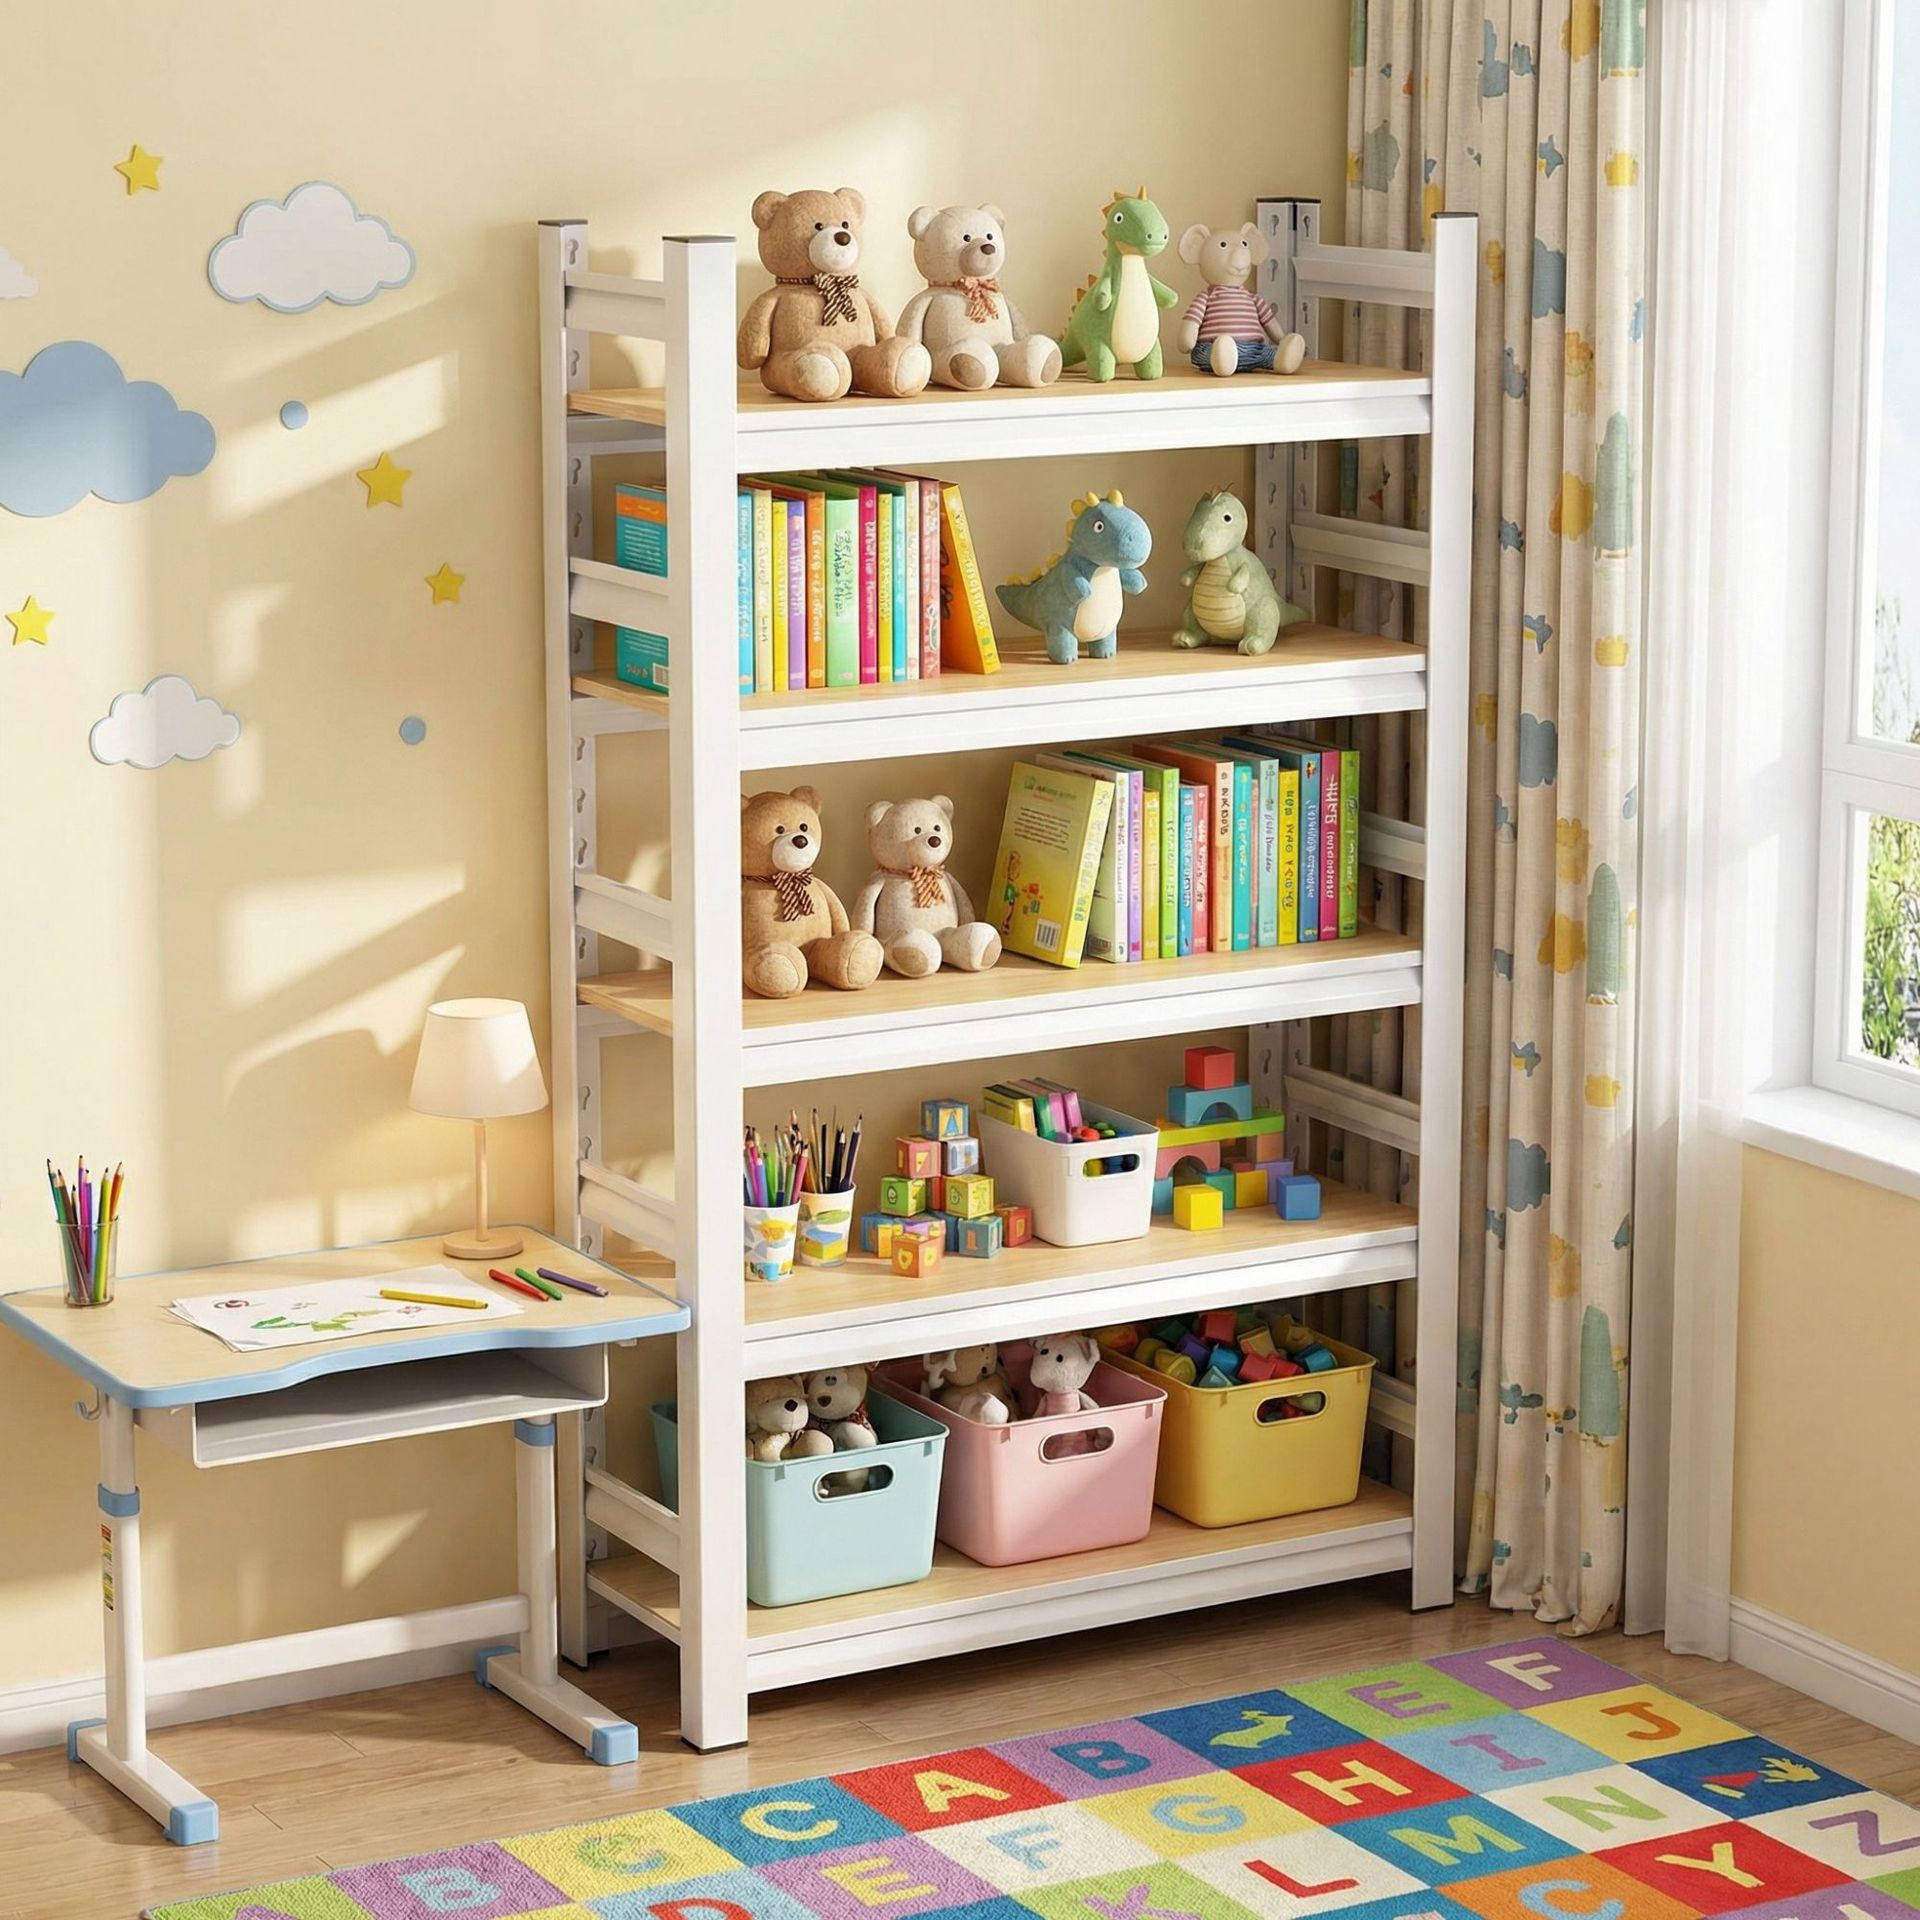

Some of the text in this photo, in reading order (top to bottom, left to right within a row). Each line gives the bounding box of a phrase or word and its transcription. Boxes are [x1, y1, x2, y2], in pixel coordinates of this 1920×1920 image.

[1485, 1652, 1561, 1691] F
[1346, 1680, 1451, 1718] E
[1600, 1702, 1681, 1740] J
[1051, 1740, 1151, 1780] B
[1450, 1733, 1547, 1771] I
[914, 1770, 1011, 1813] A
[1291, 1760, 1413, 1806] H
[740, 1801, 838, 1841] C
[1149, 1795, 1246, 1834] G
[1542, 1785, 1668, 1832] N
[986, 1822, 1060, 1871] F
[1387, 1815, 1527, 1866] M
[1808, 1810, 1920, 1856] Z
[820, 1855, 940, 1906] E
[1242, 1860, 1360, 1898] L
[1655, 1842, 1766, 1888] Y
[401, 1866, 499, 1912] B
